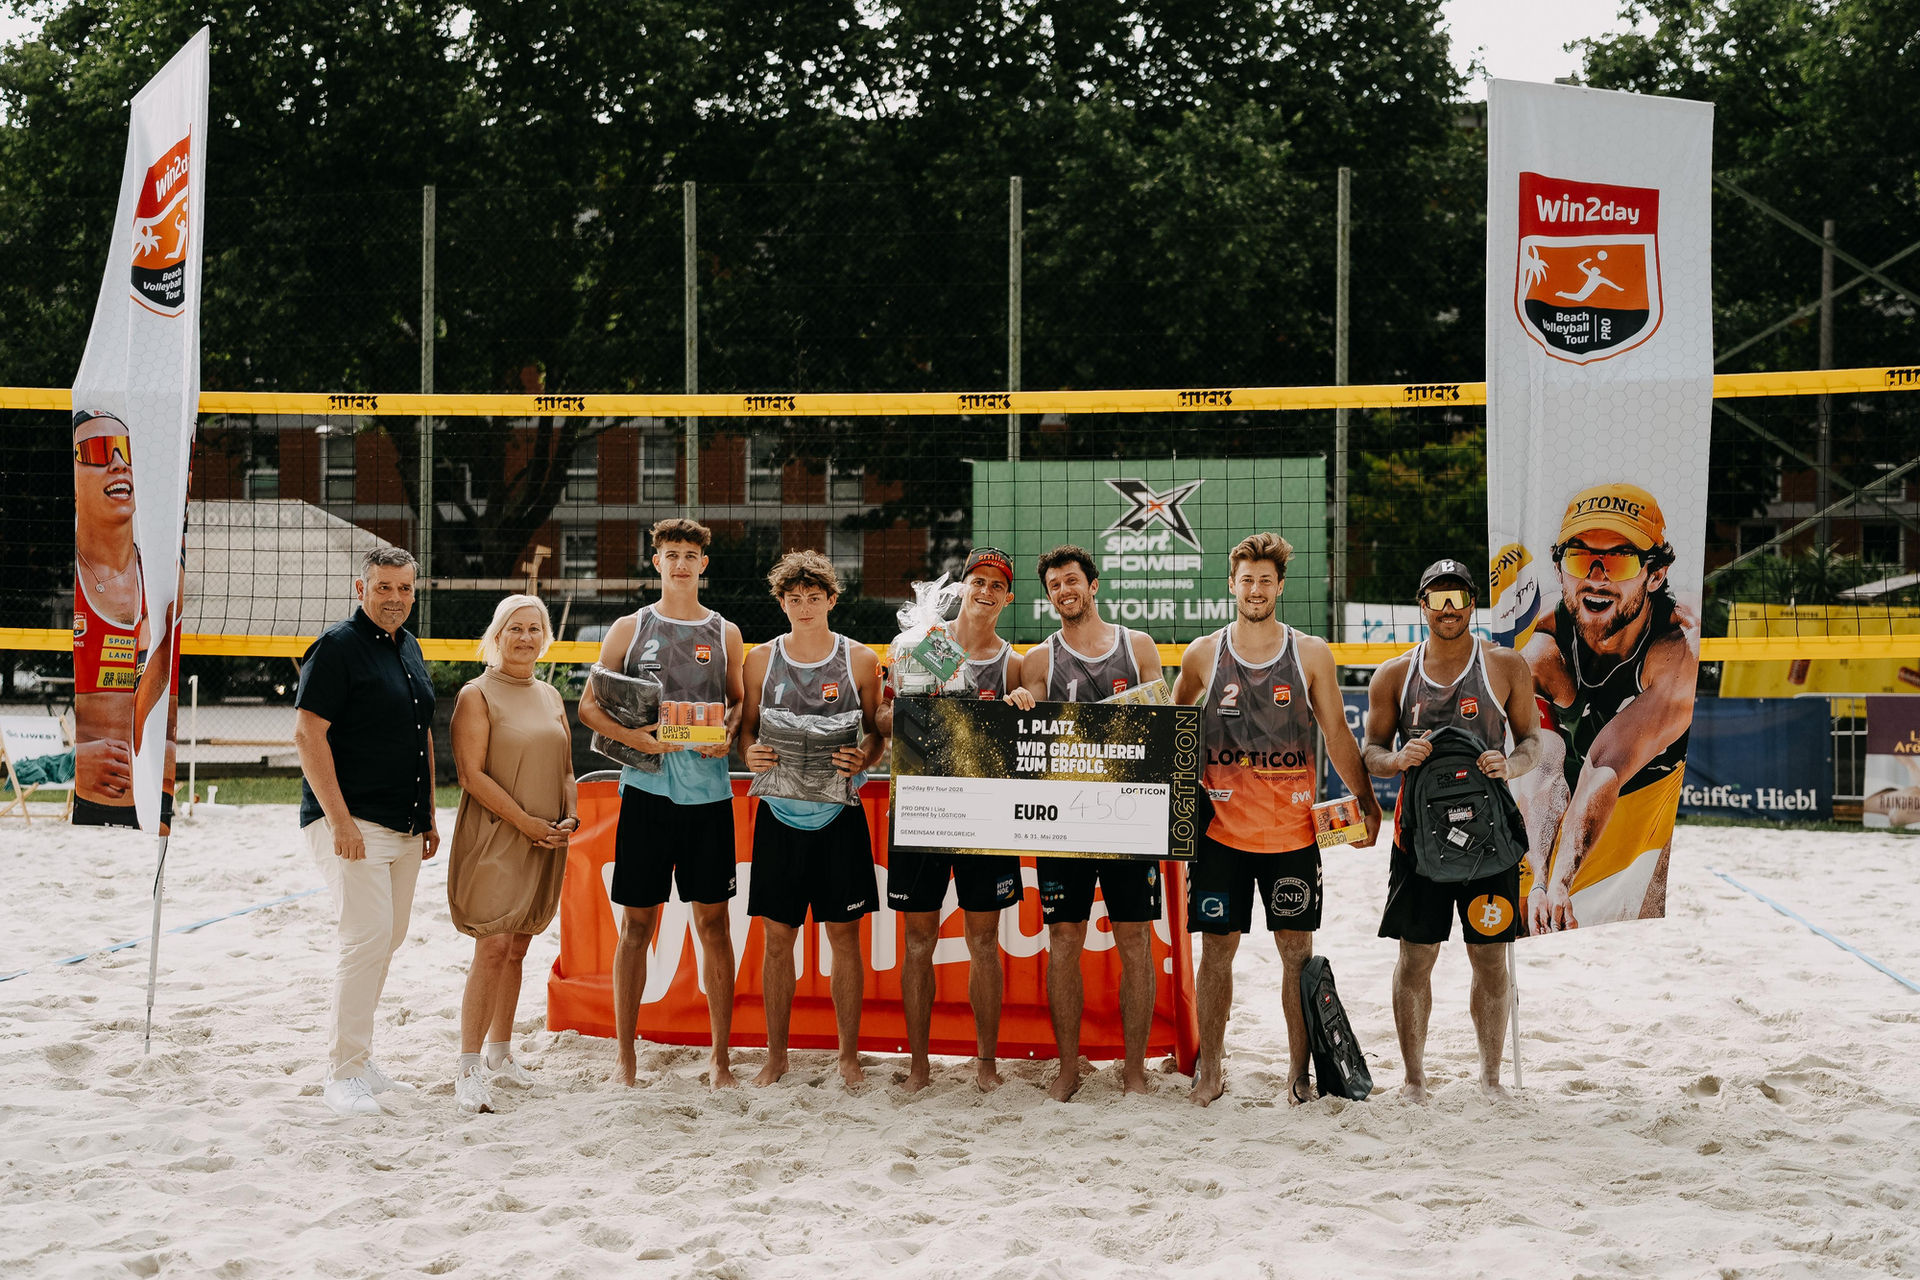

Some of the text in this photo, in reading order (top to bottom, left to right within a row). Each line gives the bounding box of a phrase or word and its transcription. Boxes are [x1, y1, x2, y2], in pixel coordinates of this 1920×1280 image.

[1536, 193, 1640, 225] Win2day
[162, 267, 182, 282] Beach
[143, 277, 182, 293] Volleyball
[165, 289, 181, 301] Tour
[1556, 311, 1590, 322] Beach
[1541, 318, 1590, 334] Volleyball
[1600, 317, 1612, 340] PRO
[1564, 334, 1589, 345] Tour
[958, 394, 1011, 410] HUCK
[1178, 391, 1233, 407] HUCK
[1403, 385, 1460, 402] HUCK
[327, 395, 378, 411] HUCK
[534, 397, 586, 412] HUCK
[744, 396, 796, 412] HUCK
[1575, 496, 1640, 517] YTONG
[1104, 532, 1172, 555] sport
[1102, 555, 1203, 572] POWER
[1107, 599, 1177, 621] YOUR
[108, 652, 133, 660] LAND
[640, 639, 660, 661] 2
[774, 683, 785, 705] 1
[1067, 679, 1078, 702] 1
[1220, 683, 1240, 707] 2
[1411, 703, 1421, 726] 1
[20, 732, 57, 740] LIWEST
[1017, 720, 1075, 735] 1. PLATZ
[1016, 741, 1146, 760] WIR GRATULIEREN
[1016, 757, 1109, 775] ZUM ERFOLG.
[1069, 790, 1137, 821] 450
[1756, 787, 1818, 811] Hiebl
[1014, 804, 1058, 821] EURO
[846, 899, 866, 911] CRAFT
[1275, 892, 1303, 903] CNE
